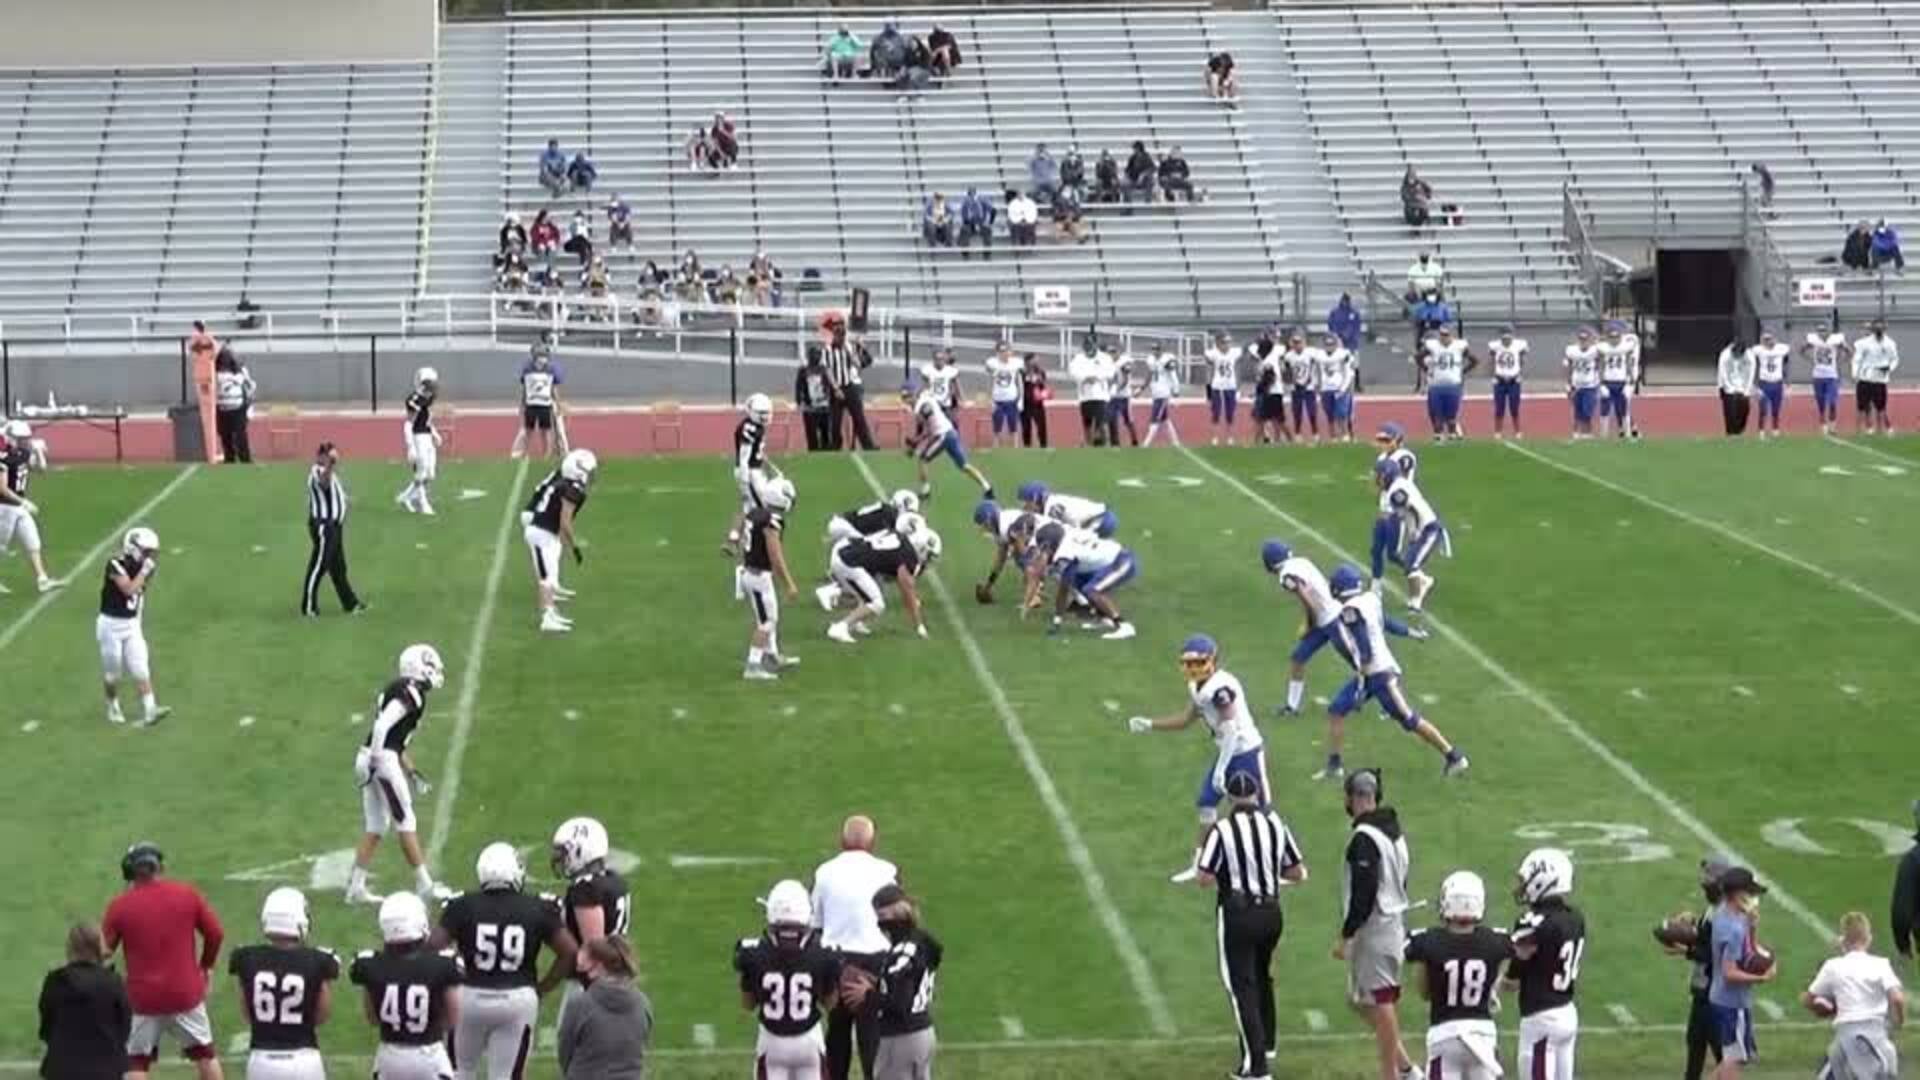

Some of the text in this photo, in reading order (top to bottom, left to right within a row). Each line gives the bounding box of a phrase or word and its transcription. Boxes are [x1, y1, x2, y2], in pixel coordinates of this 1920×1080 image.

[473, 922, 526, 972] 59
[253, 971, 305, 1025] 62
[762, 972, 813, 1021] 36
[1444, 958, 1487, 1007] 18
[379, 983, 430, 1033] 49
